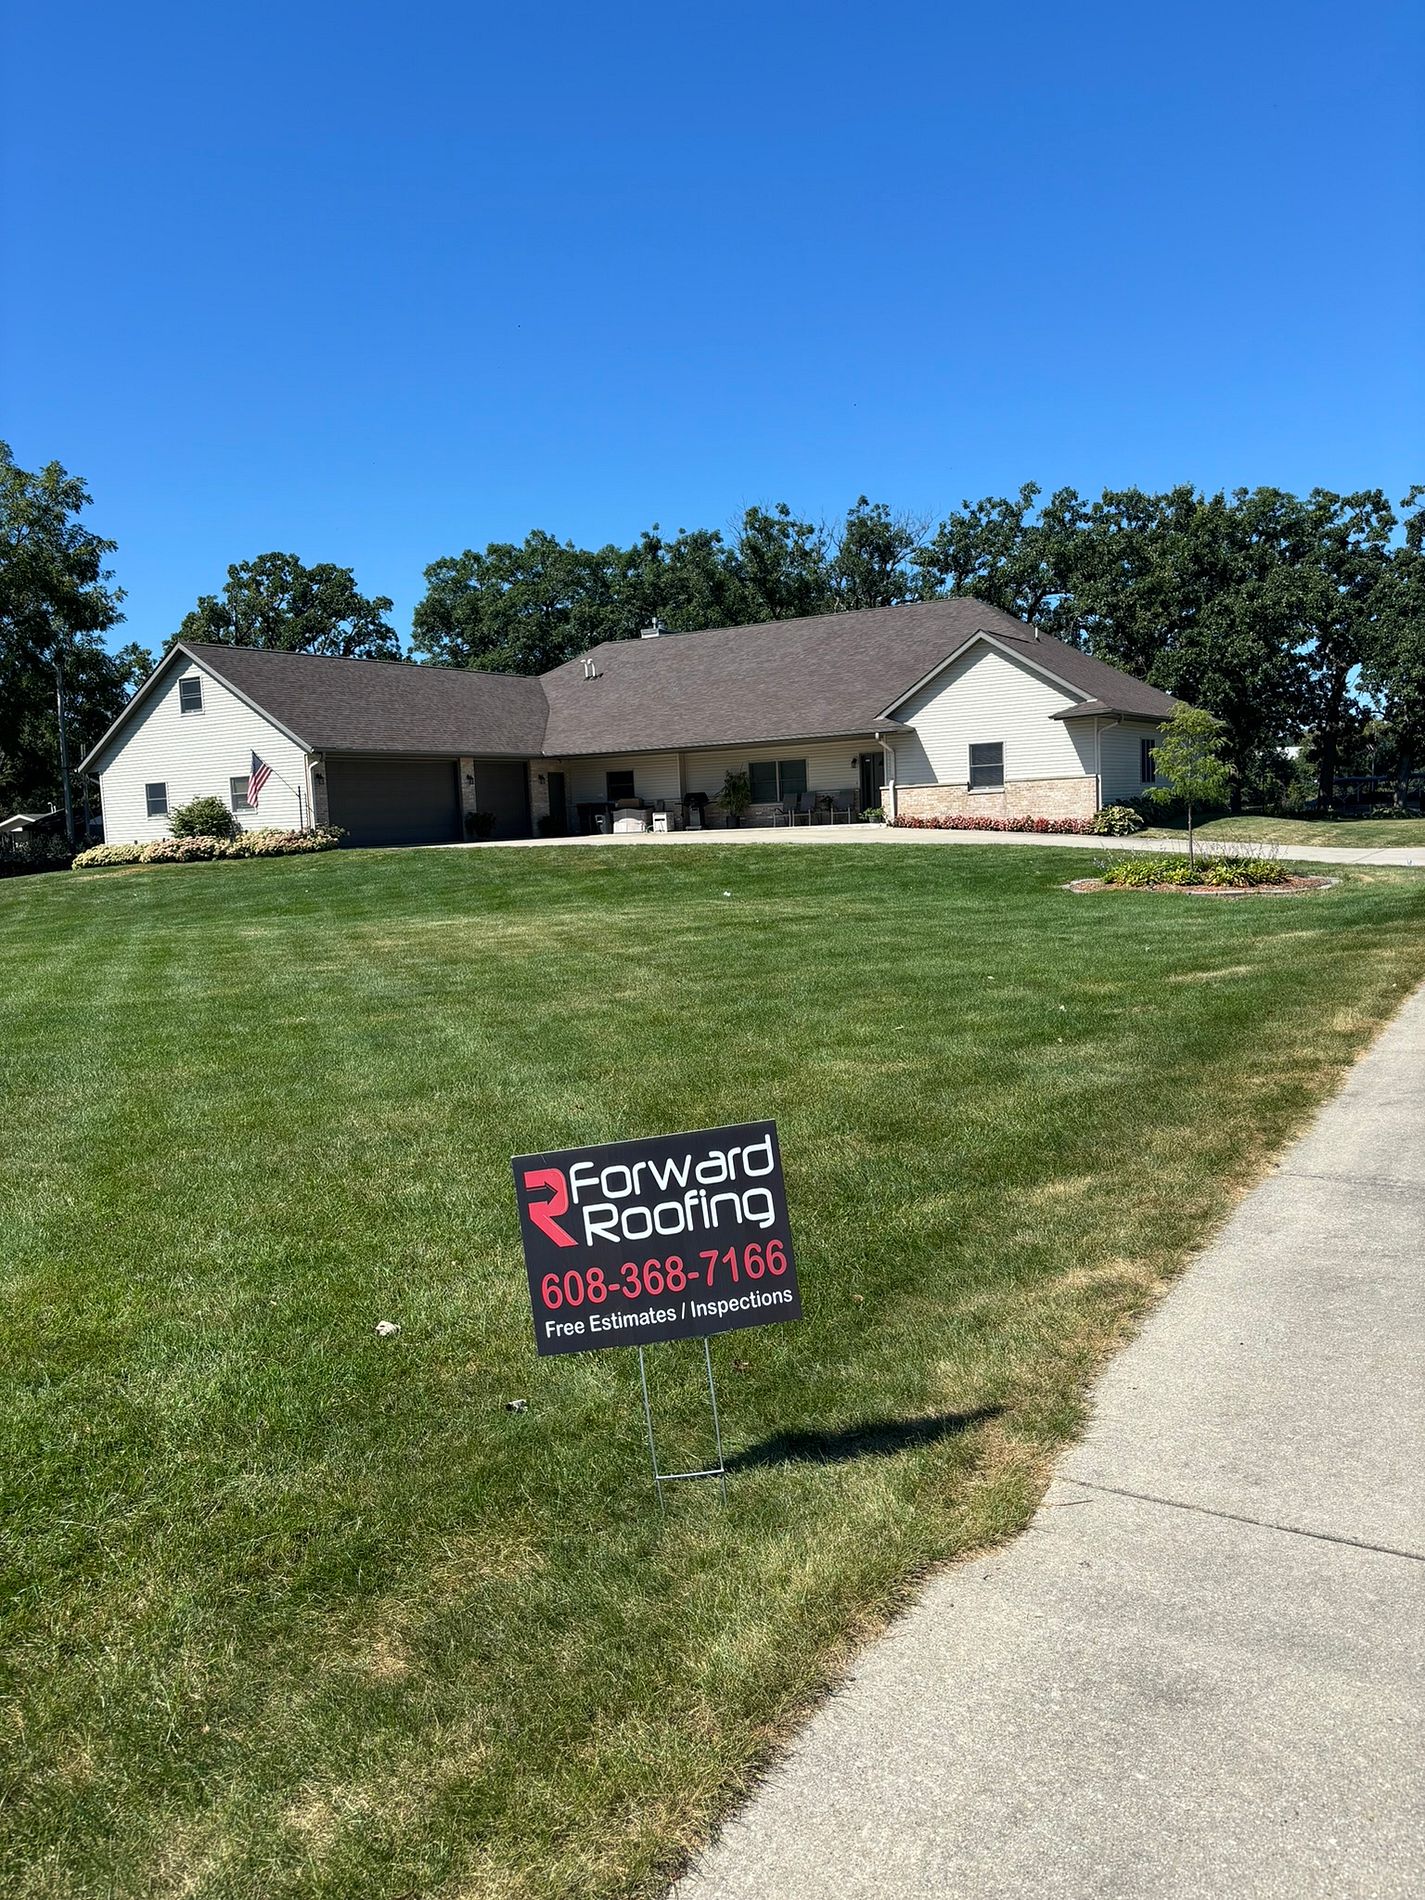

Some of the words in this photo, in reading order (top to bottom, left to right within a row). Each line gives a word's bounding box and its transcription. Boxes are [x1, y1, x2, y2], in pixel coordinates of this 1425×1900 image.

[568, 1133, 775, 1205] Forward
[582, 1187, 776, 1247] Roofing
[541, 1239, 788, 1310] 608-368-7166
[545, 1320, 586, 1339] Free
[589, 1306, 677, 1333] Estimates
[681, 1301, 686, 1320] /
[690, 1288, 793, 1319] Inspections
